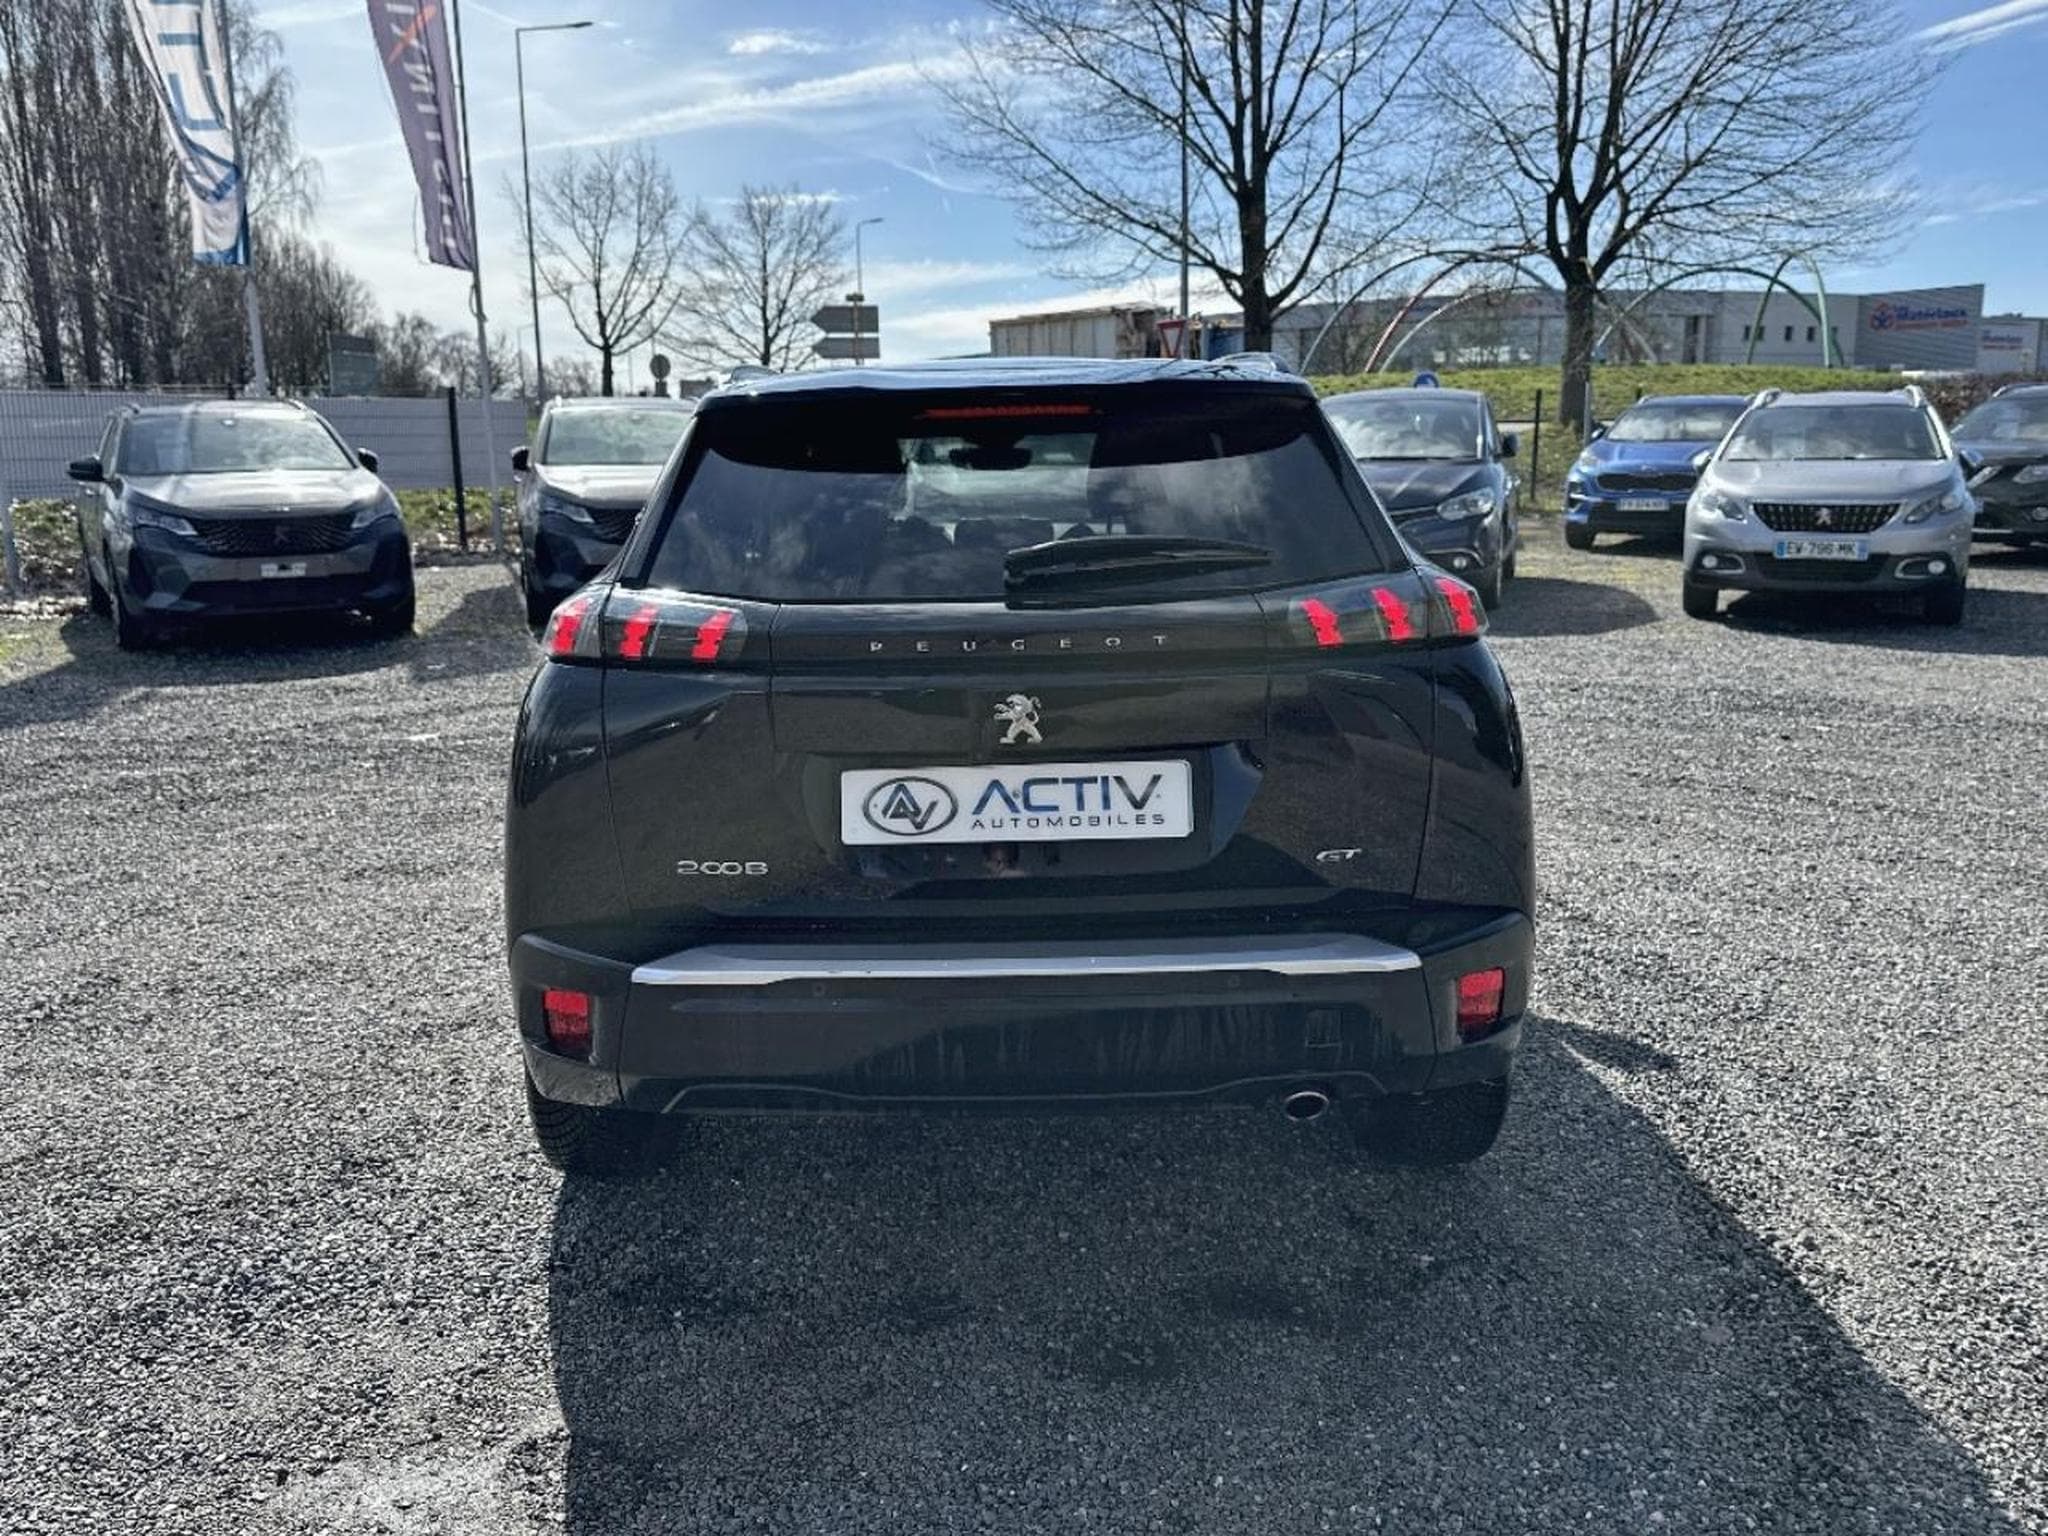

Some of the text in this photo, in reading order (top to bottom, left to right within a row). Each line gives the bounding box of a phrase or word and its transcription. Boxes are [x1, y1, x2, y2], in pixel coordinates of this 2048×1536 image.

[868, 634, 1167, 652] PEUGEOT
[972, 774, 1163, 815] ACTIV
[971, 814, 1165, 830] AUTOMOBILES
[1315, 848, 1362, 861] GT
[677, 860, 769, 874] 2008
